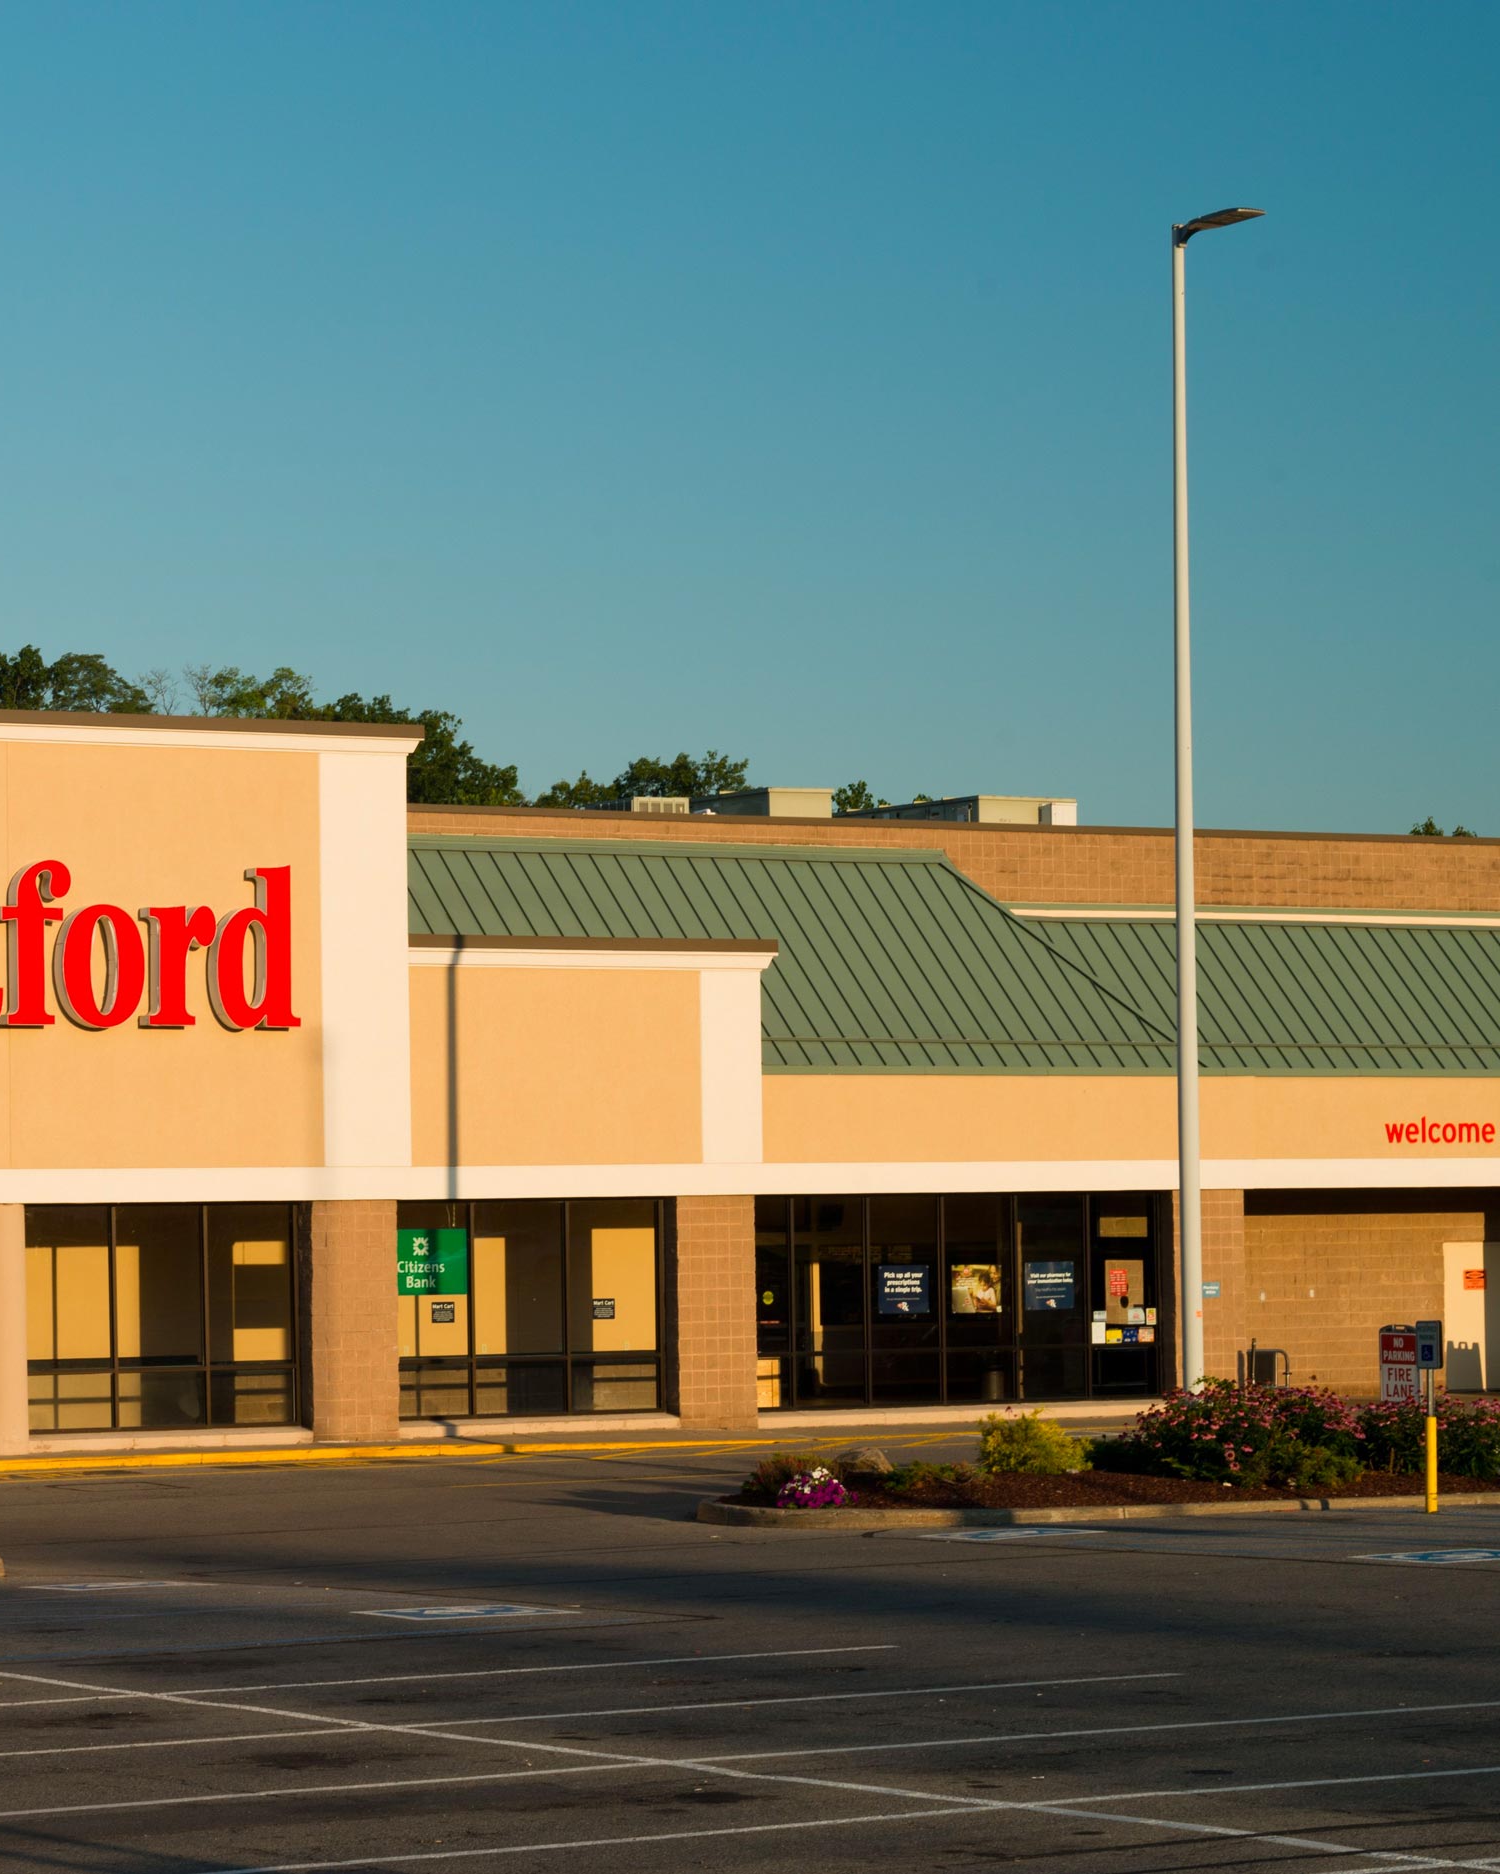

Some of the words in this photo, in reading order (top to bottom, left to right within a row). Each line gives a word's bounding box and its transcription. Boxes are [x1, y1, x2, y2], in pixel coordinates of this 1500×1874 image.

[1384, 1115, 1496, 1144] welcome
[397, 1260, 446, 1273] Citizens
[883, 1271, 896, 1279] Pick
[405, 1275, 437, 1289] Bank
[886, 1279, 921, 1287] prescriptions
[1393, 1337, 1404, 1348] NO
[1383, 1350, 1415, 1362] PARKING
[1387, 1367, 1412, 1382] FIRE
[1386, 1383, 1415, 1398] LANE
